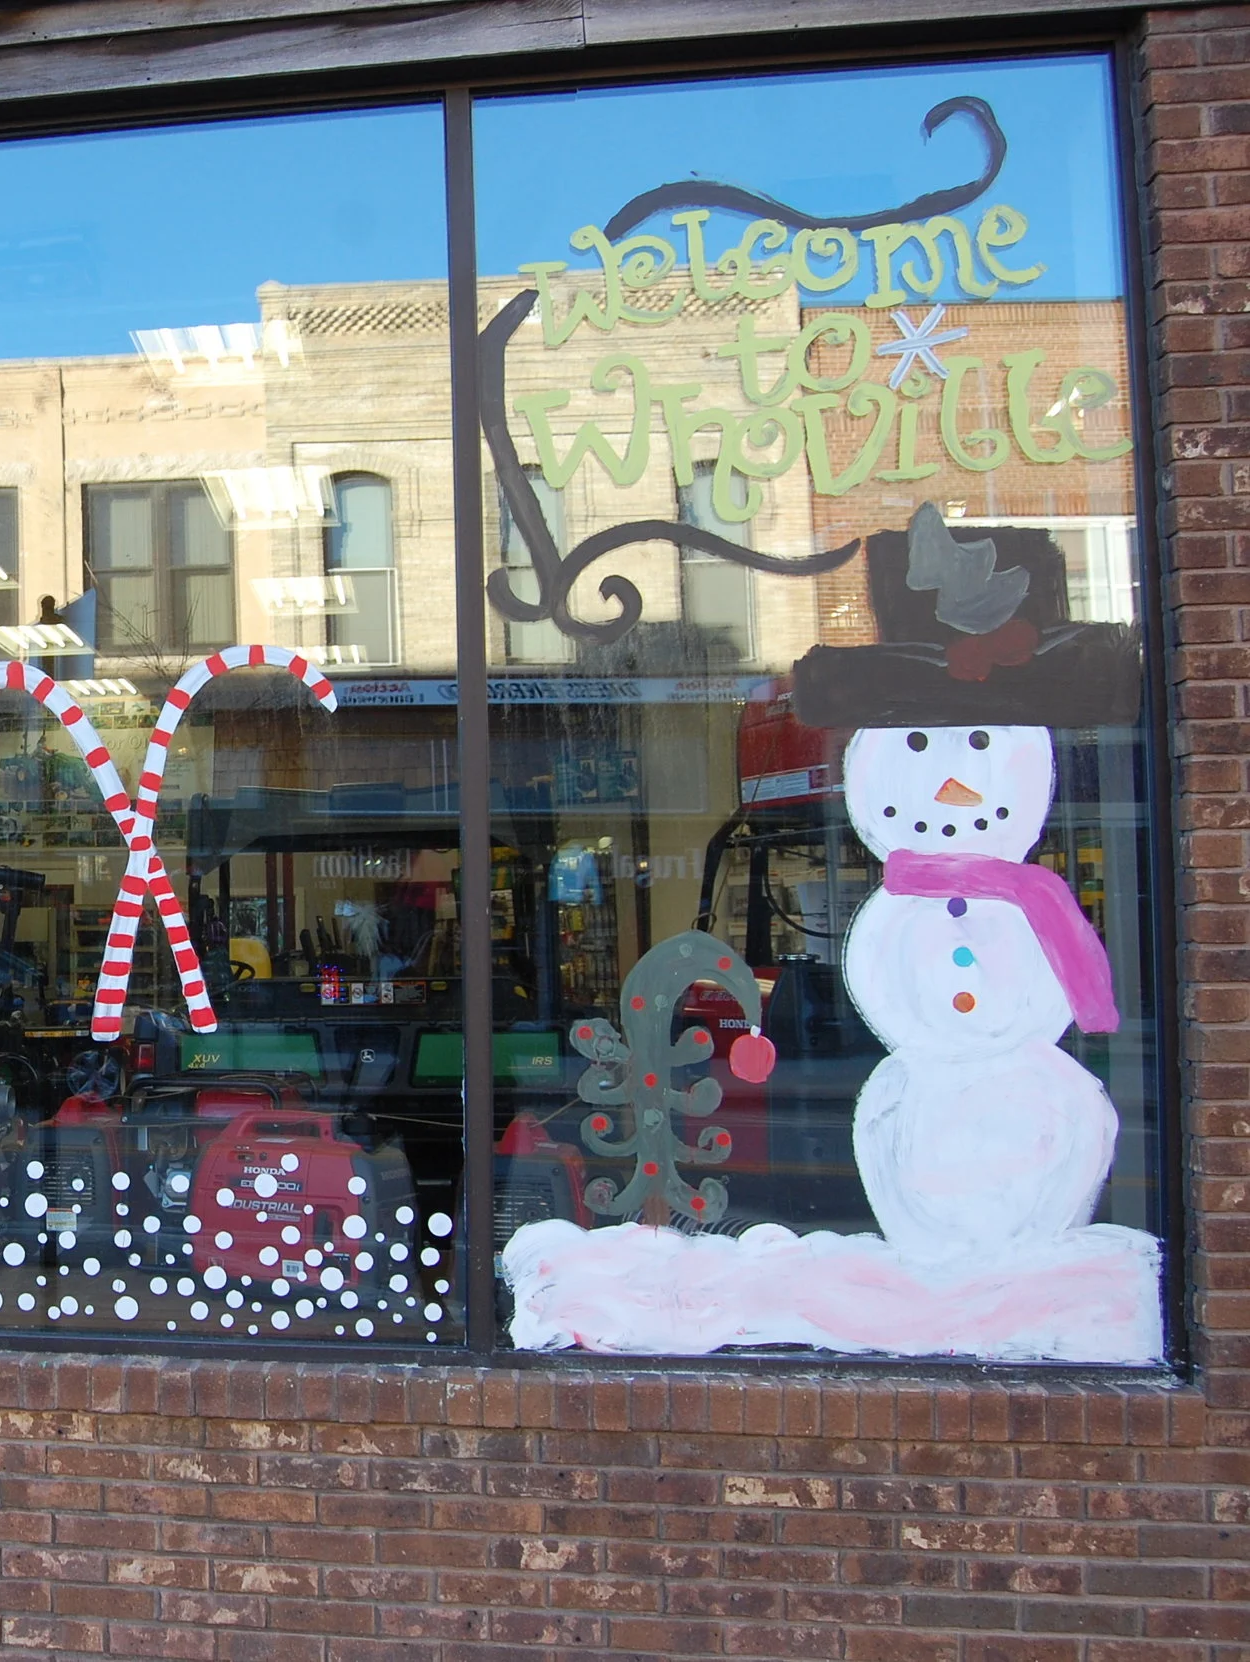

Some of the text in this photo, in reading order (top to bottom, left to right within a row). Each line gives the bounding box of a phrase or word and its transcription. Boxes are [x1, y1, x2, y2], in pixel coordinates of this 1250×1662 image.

[718, 312, 871, 405] to
[718, 1018, 751, 1029] HOND
[193, 1053, 221, 1063] XUV
[531, 1056, 554, 1066] IRS
[243, 1166, 286, 1176] HONDA
